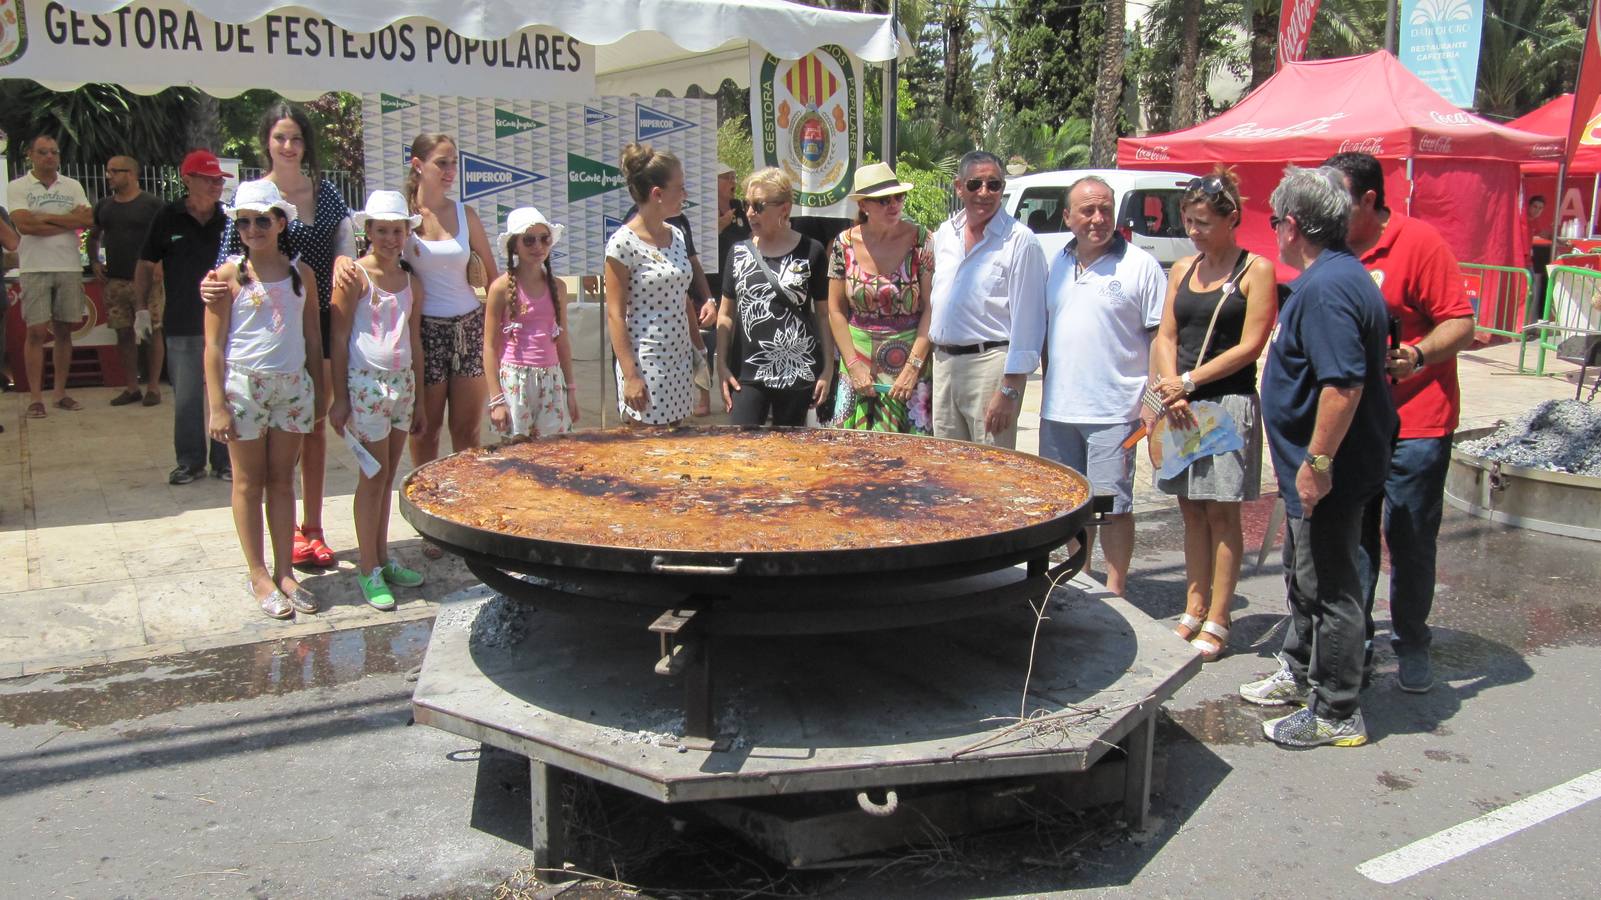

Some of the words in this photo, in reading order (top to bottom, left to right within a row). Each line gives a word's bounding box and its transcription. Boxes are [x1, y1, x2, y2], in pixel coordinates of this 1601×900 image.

[45, 1, 203, 51] GESTORA
[215, 20, 255, 53] DE
[266, 15, 417, 62] FESTEJOS
[426, 25, 582, 73] POPULARES
[1410, 41, 1468, 53] RESTAURANTE
[640, 119, 674, 129] HIPERCOR
[763, 80, 775, 154] GESTORA
[847, 77, 858, 160] POPULARES
[466, 171, 513, 183] HIPERCOR
[579, 171, 601, 183] Corte
[792, 191, 836, 208] ELCHE
